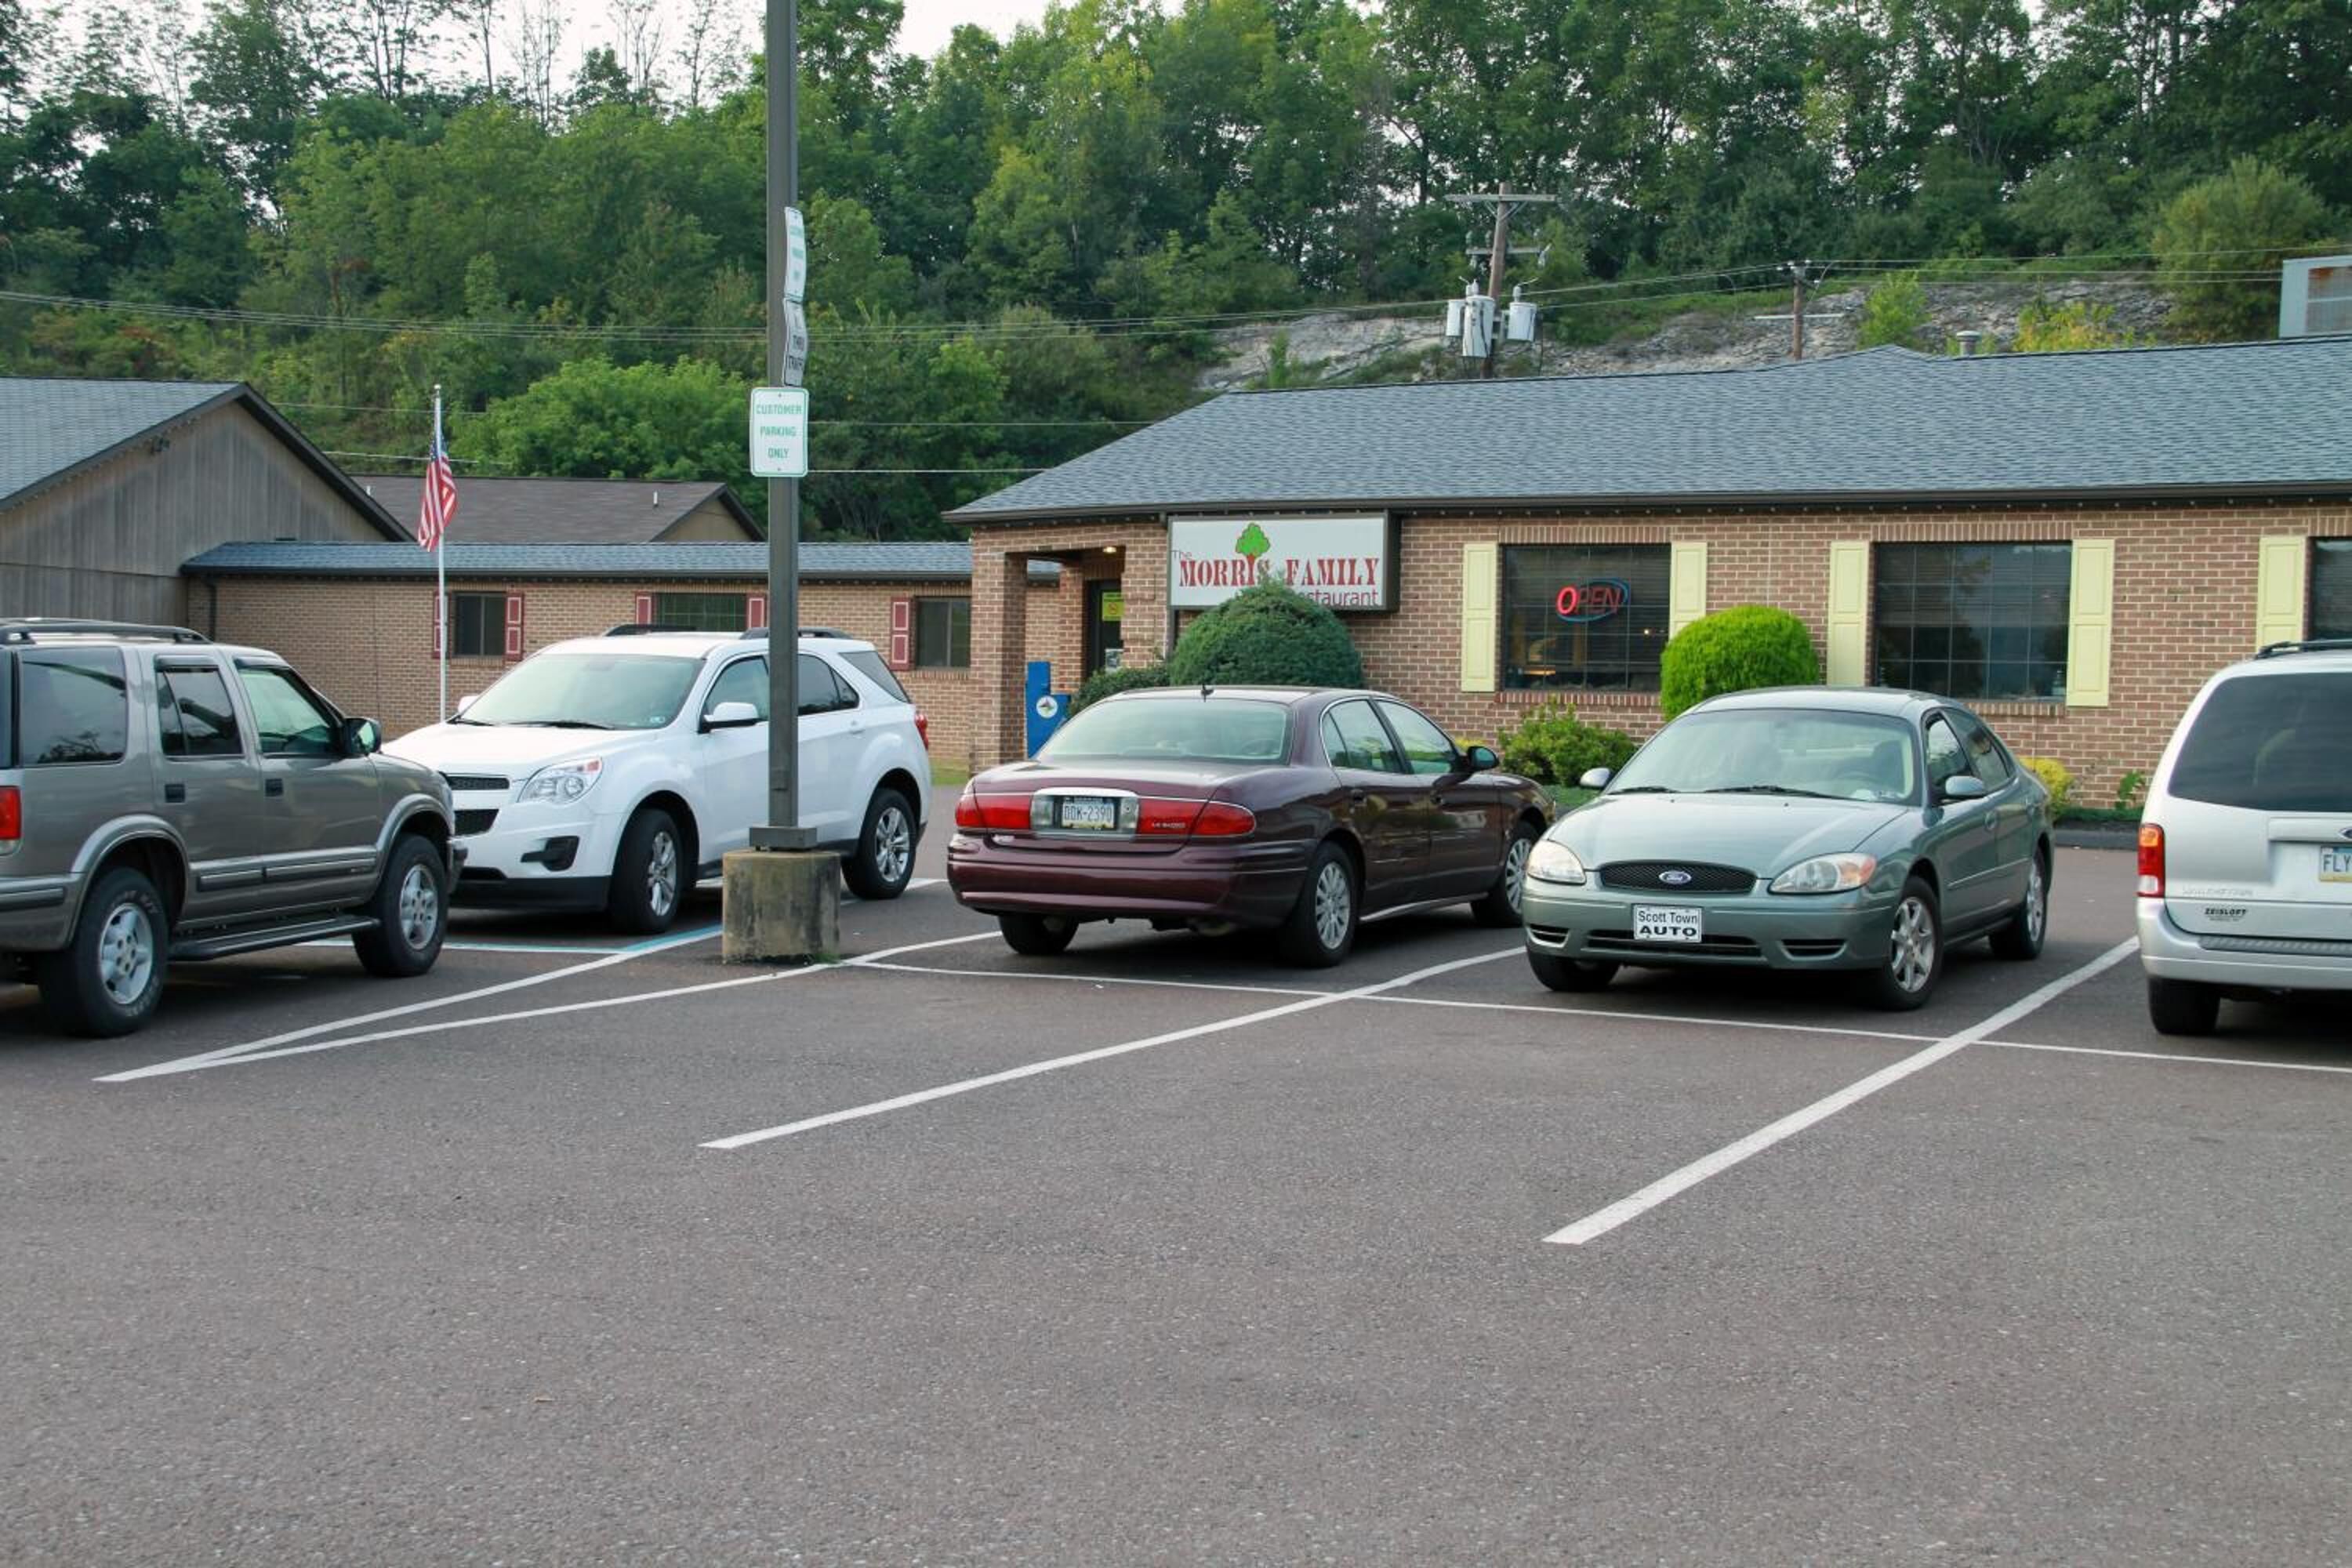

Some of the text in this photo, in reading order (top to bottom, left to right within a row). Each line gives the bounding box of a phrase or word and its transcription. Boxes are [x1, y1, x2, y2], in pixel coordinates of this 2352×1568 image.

[756, 404, 802, 415] CUSTOMER
[760, 426, 797, 437] PARKING
[768, 448, 789, 459] ONLY
[1286, 557, 1379, 586] FAMILY
[1556, 585, 1621, 615] OPEN
[1638, 910, 1697, 924] Scott Town
[1639, 926, 1697, 937] AUTO
